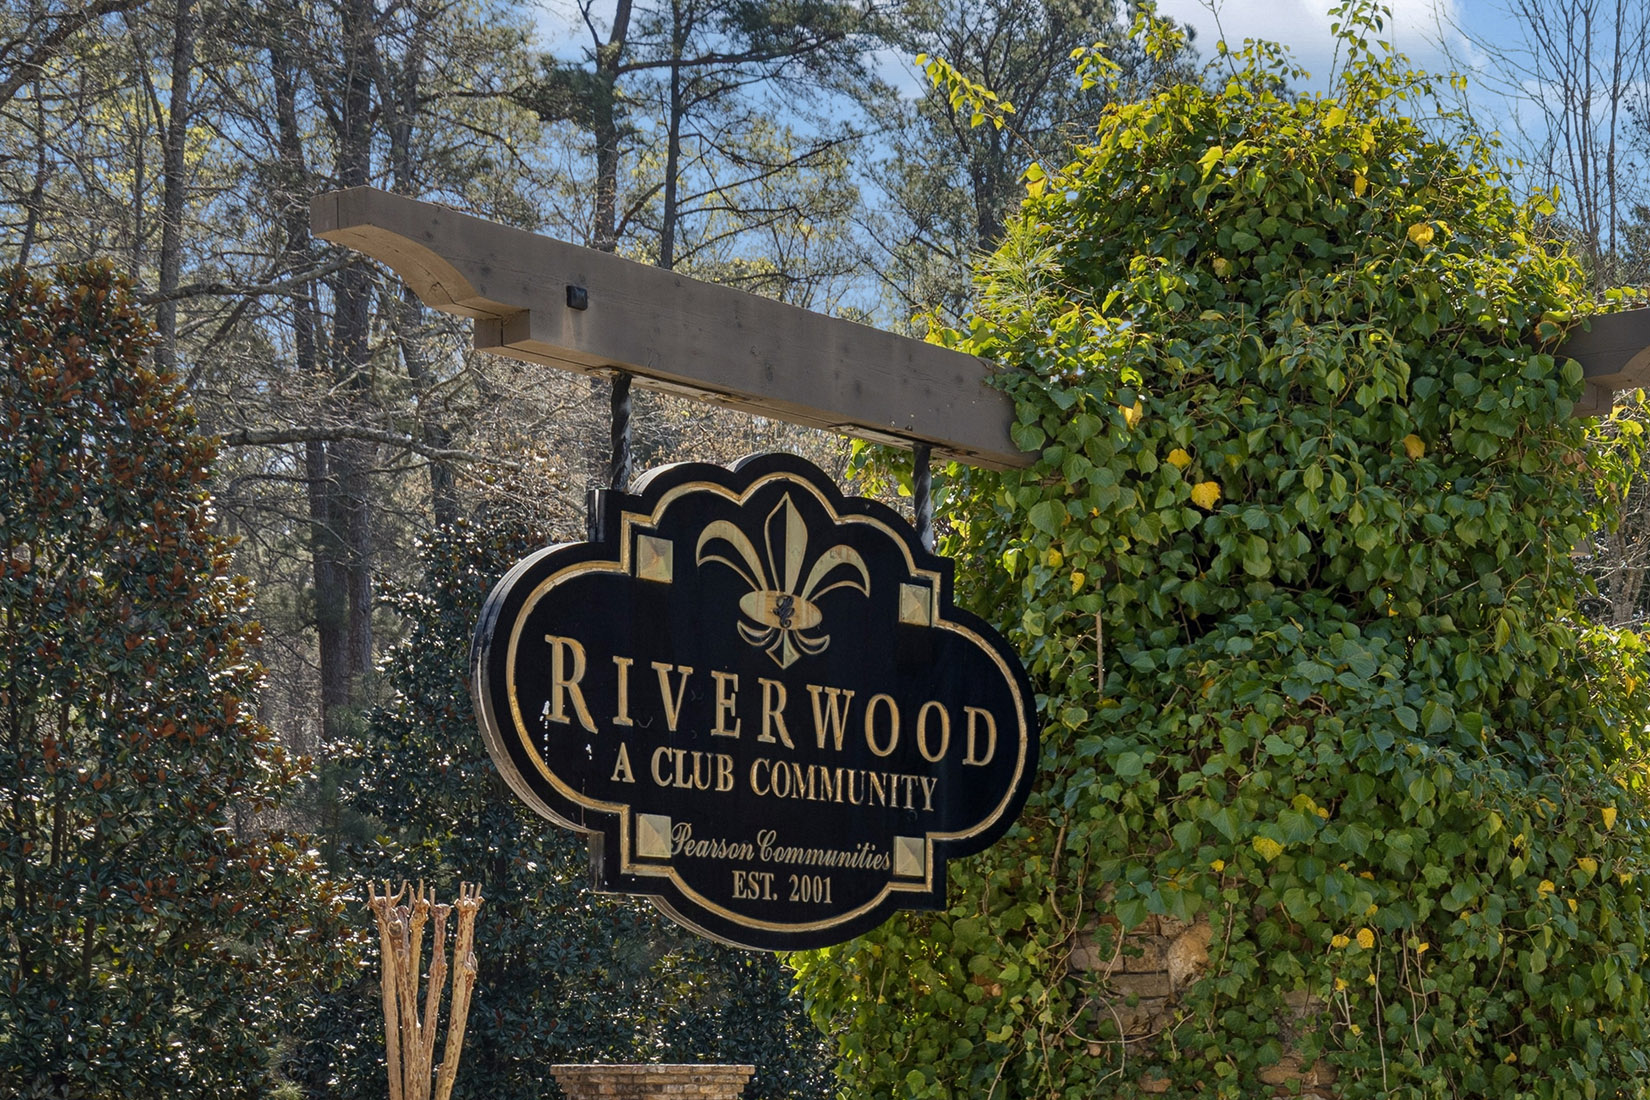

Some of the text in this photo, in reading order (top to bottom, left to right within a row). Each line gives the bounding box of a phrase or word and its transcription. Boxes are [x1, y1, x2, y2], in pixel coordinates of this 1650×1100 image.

[544, 634, 998, 767] RIVERWOOD
[610, 742, 938, 812] A CLUB COMMUNITY
[671, 821, 892, 870] Pearson Communities
[731, 869, 833, 904] EST. 2001
